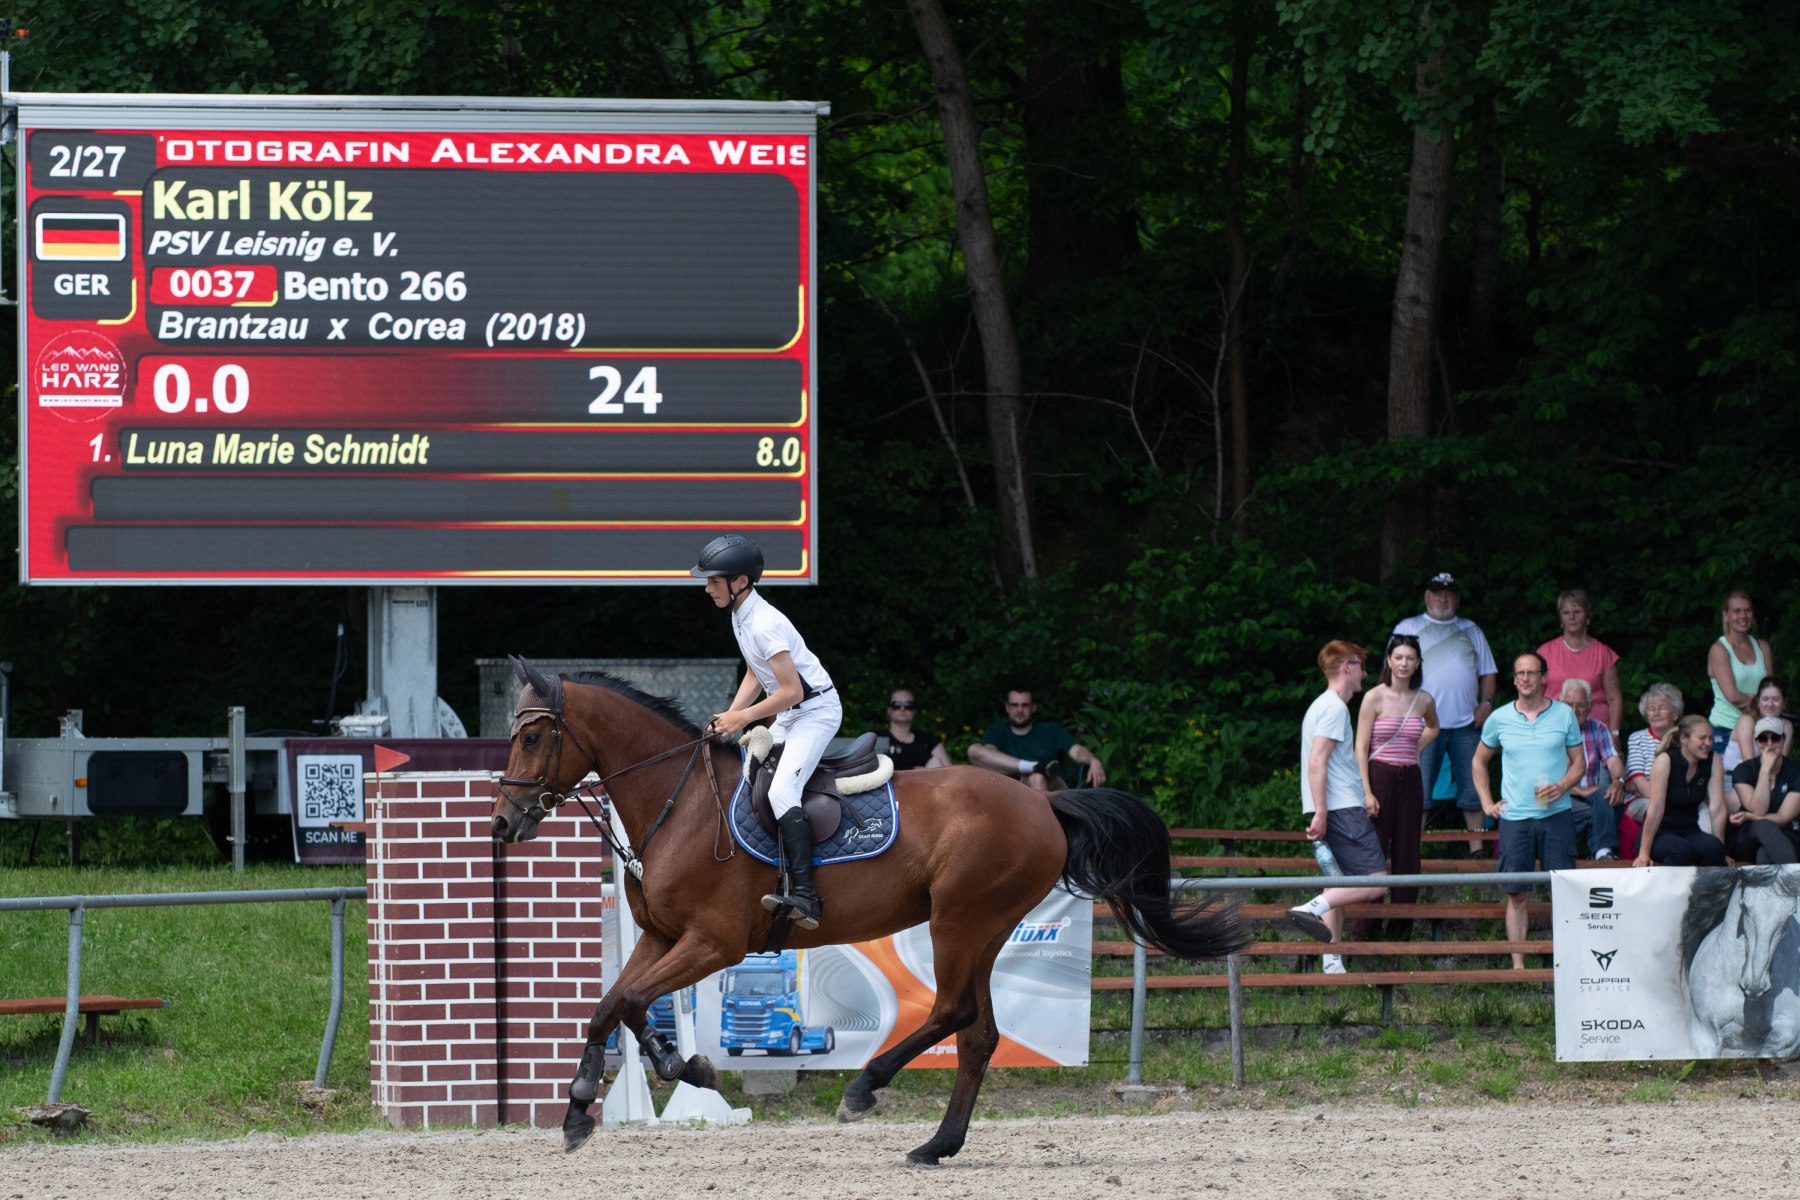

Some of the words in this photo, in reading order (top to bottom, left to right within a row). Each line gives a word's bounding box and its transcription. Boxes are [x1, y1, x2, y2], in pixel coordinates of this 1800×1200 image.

[49, 145, 127, 178] 2/27
[160, 136, 410, 163] OTOGRAFIN
[430, 138, 691, 165] ALEXANDRA
[153, 179, 251, 221] Karl
[268, 179, 374, 222] Kölz
[148, 231, 213, 256] PSV
[216, 231, 327, 262] Leisnig
[332, 238, 360, 257] e.
[373, 232, 399, 257] V.
[53, 273, 111, 296] GER
[169, 270, 255, 298] 0037
[283, 270, 389, 302] Bento
[399, 270, 468, 302] 266
[158, 310, 310, 340] Brantzau
[326, 318, 350, 340] x
[368, 312, 467, 341] Corea
[485, 312, 586, 347] (2018)
[41, 363, 70, 372] LED
[75, 363, 120, 372] WAND
[41, 373, 120, 389] HARZ
[153, 363, 250, 414] 0.0
[588, 365, 664, 415] 24
[89, 433, 111, 463] 1.
[126, 433, 204, 465] Luna
[211, 433, 295, 465] Marie
[303, 433, 430, 465] Schmidt
[756, 436, 800, 467] 8.0
[305, 831, 338, 844] SCAN
[341, 831, 358, 844] ME
[1578, 912, 1622, 920] SEAT
[1042, 949, 1072, 959] logistics
[1581, 1033, 1621, 1044] Service
